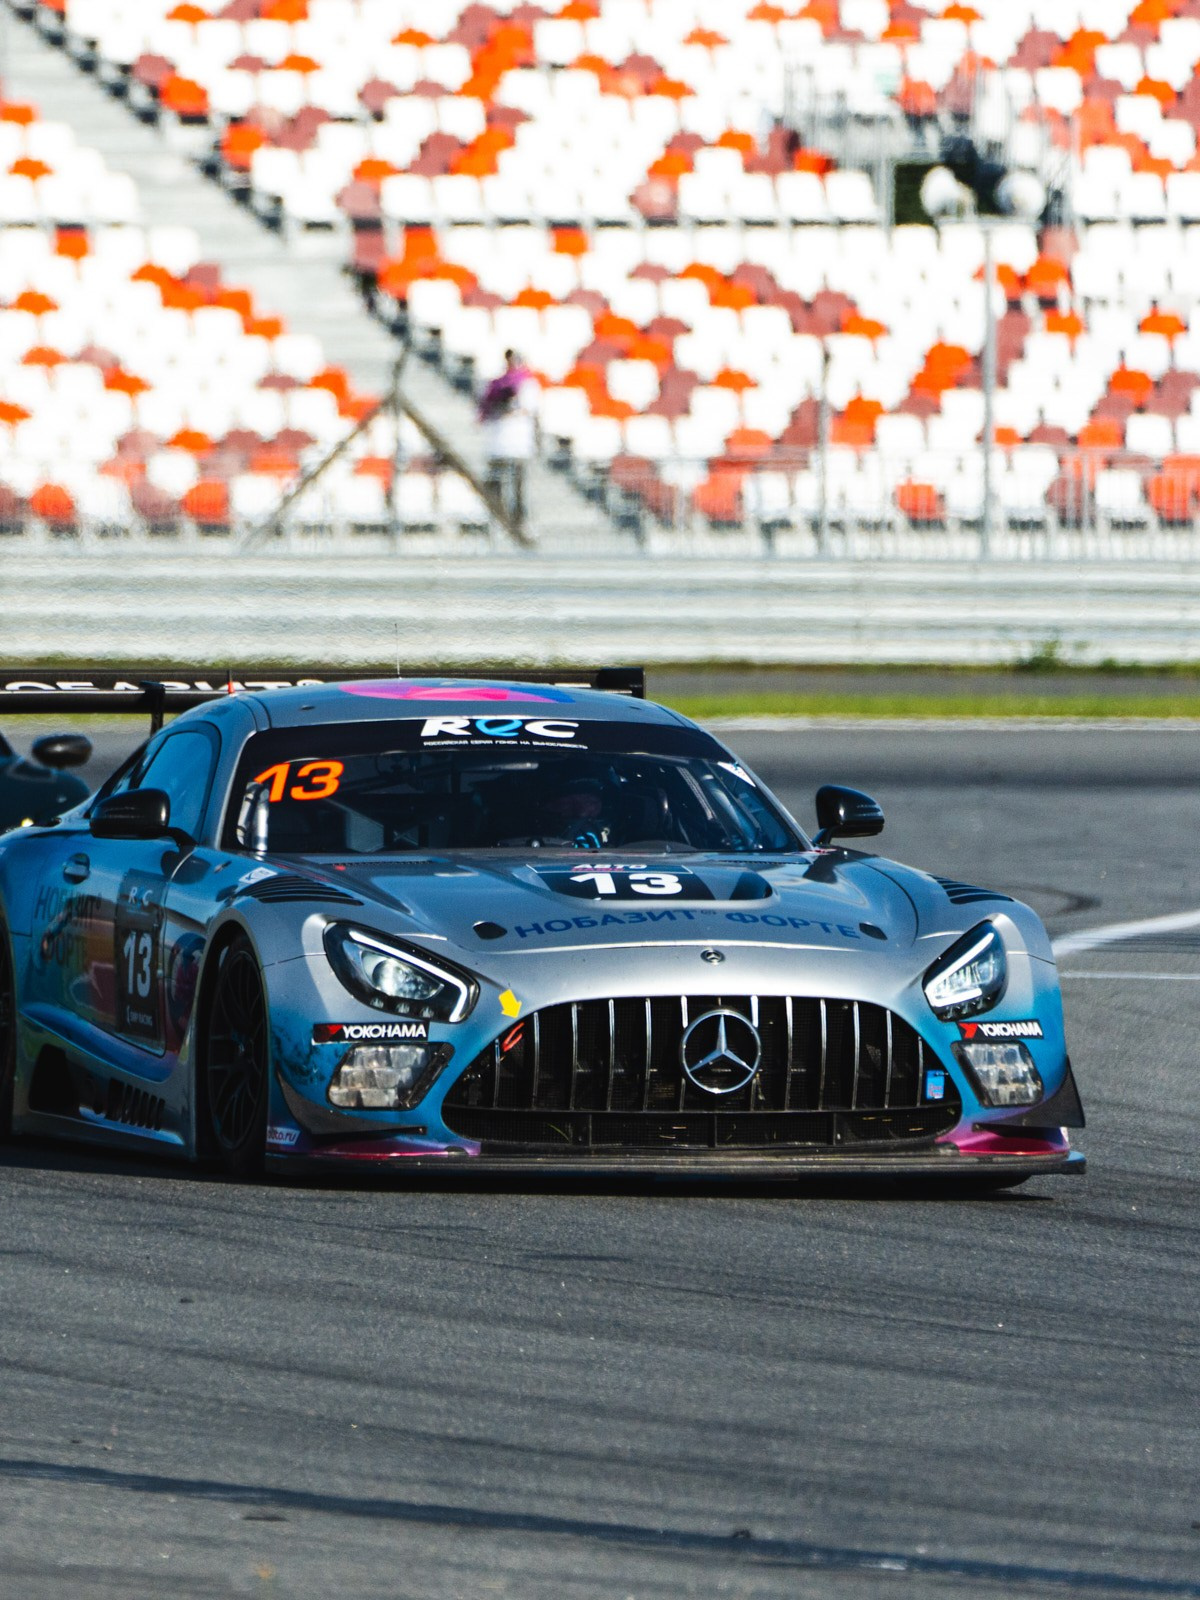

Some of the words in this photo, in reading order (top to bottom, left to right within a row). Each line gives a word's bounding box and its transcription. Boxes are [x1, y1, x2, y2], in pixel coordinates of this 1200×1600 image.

[253, 760, 345, 803] 13
[569, 873, 683, 896] 13
[513, 909, 698, 939] НОБАЗИТ
[725, 912, 861, 941] ФОРТЕ
[123, 931, 154, 998] 13
[342, 1024, 427, 1039] YOKOHAMA
[977, 1021, 1043, 1037] YOKOHAMA
